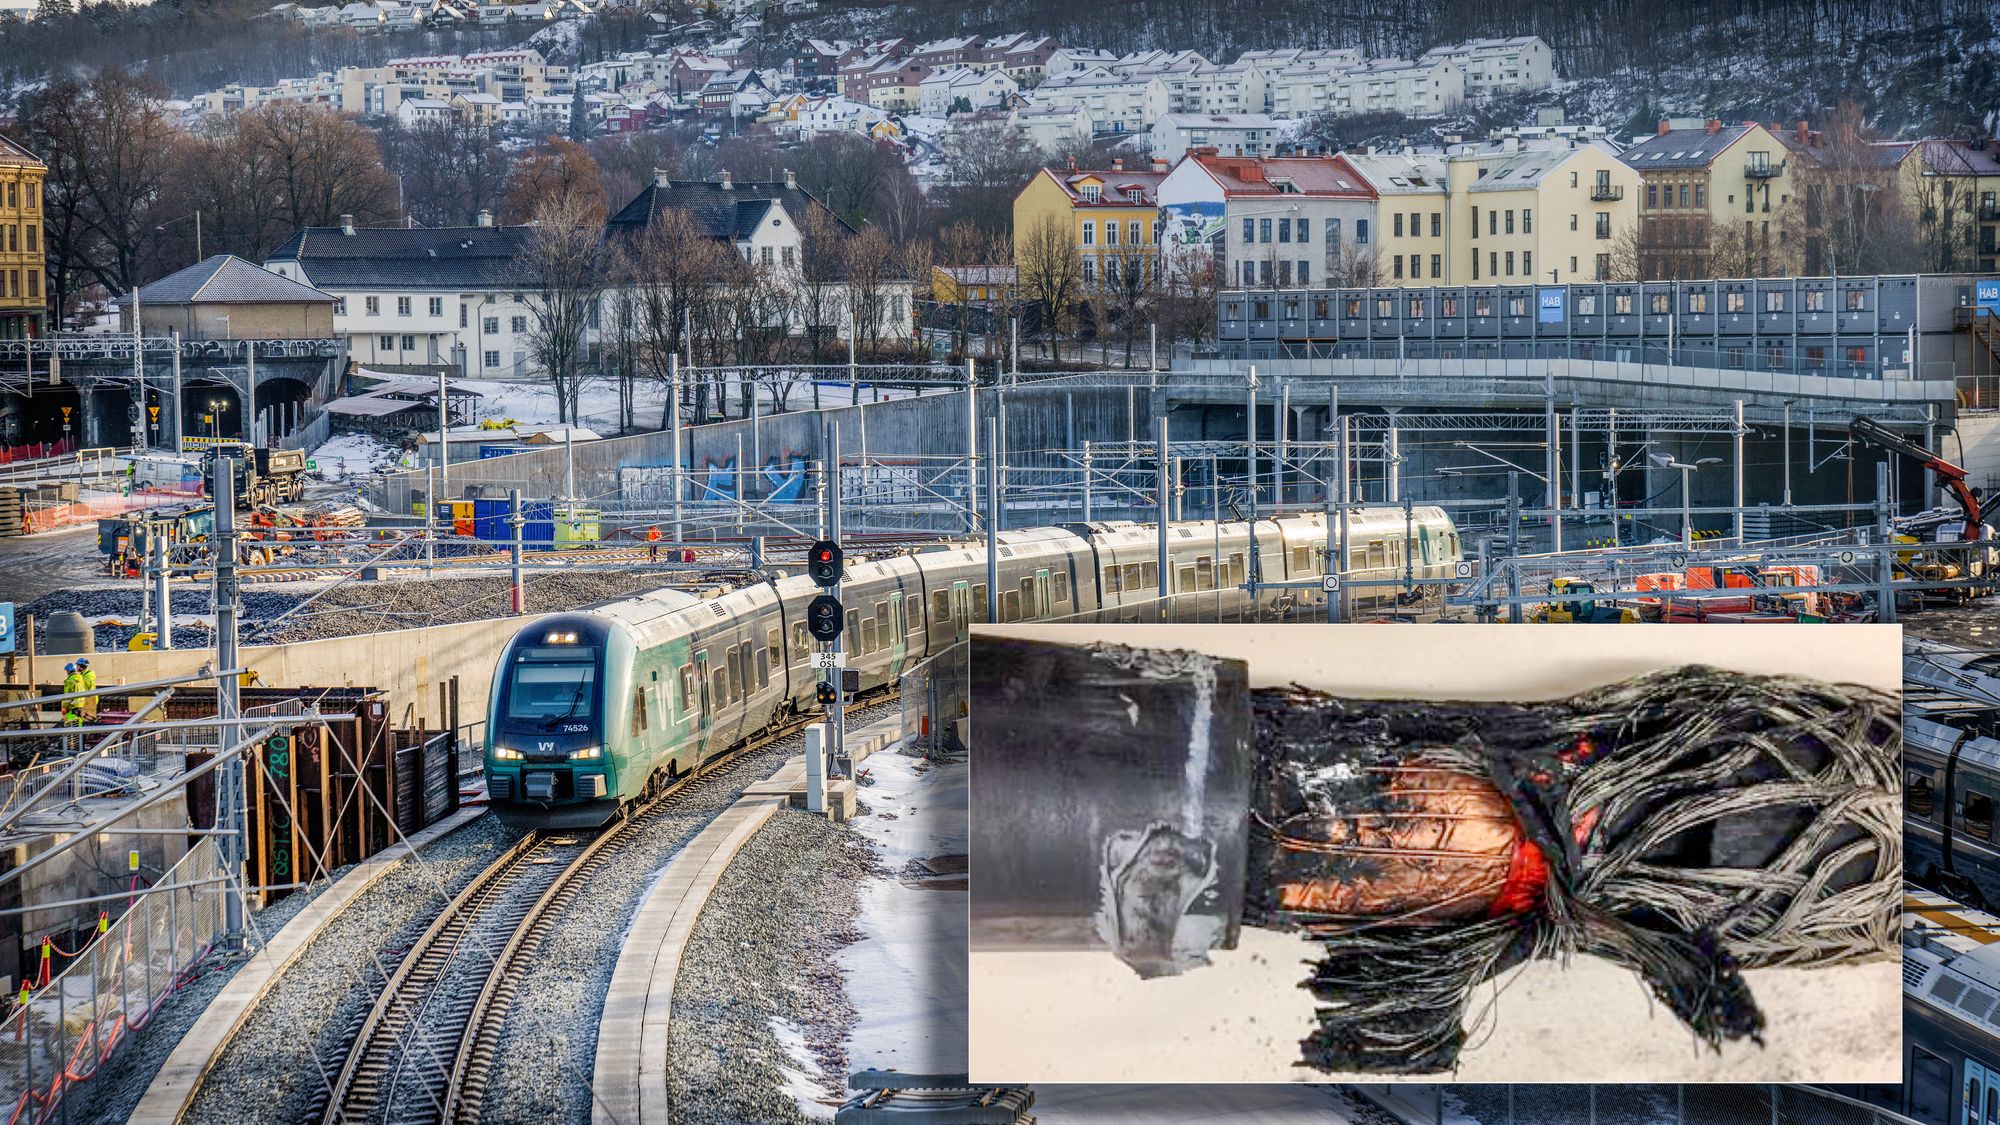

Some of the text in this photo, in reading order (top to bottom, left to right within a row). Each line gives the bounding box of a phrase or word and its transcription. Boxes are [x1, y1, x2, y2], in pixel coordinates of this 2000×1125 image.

[1979, 288, 1998, 299] HAB
[1542, 296, 1560, 306] HAB
[269, 737, 289, 779] 780
